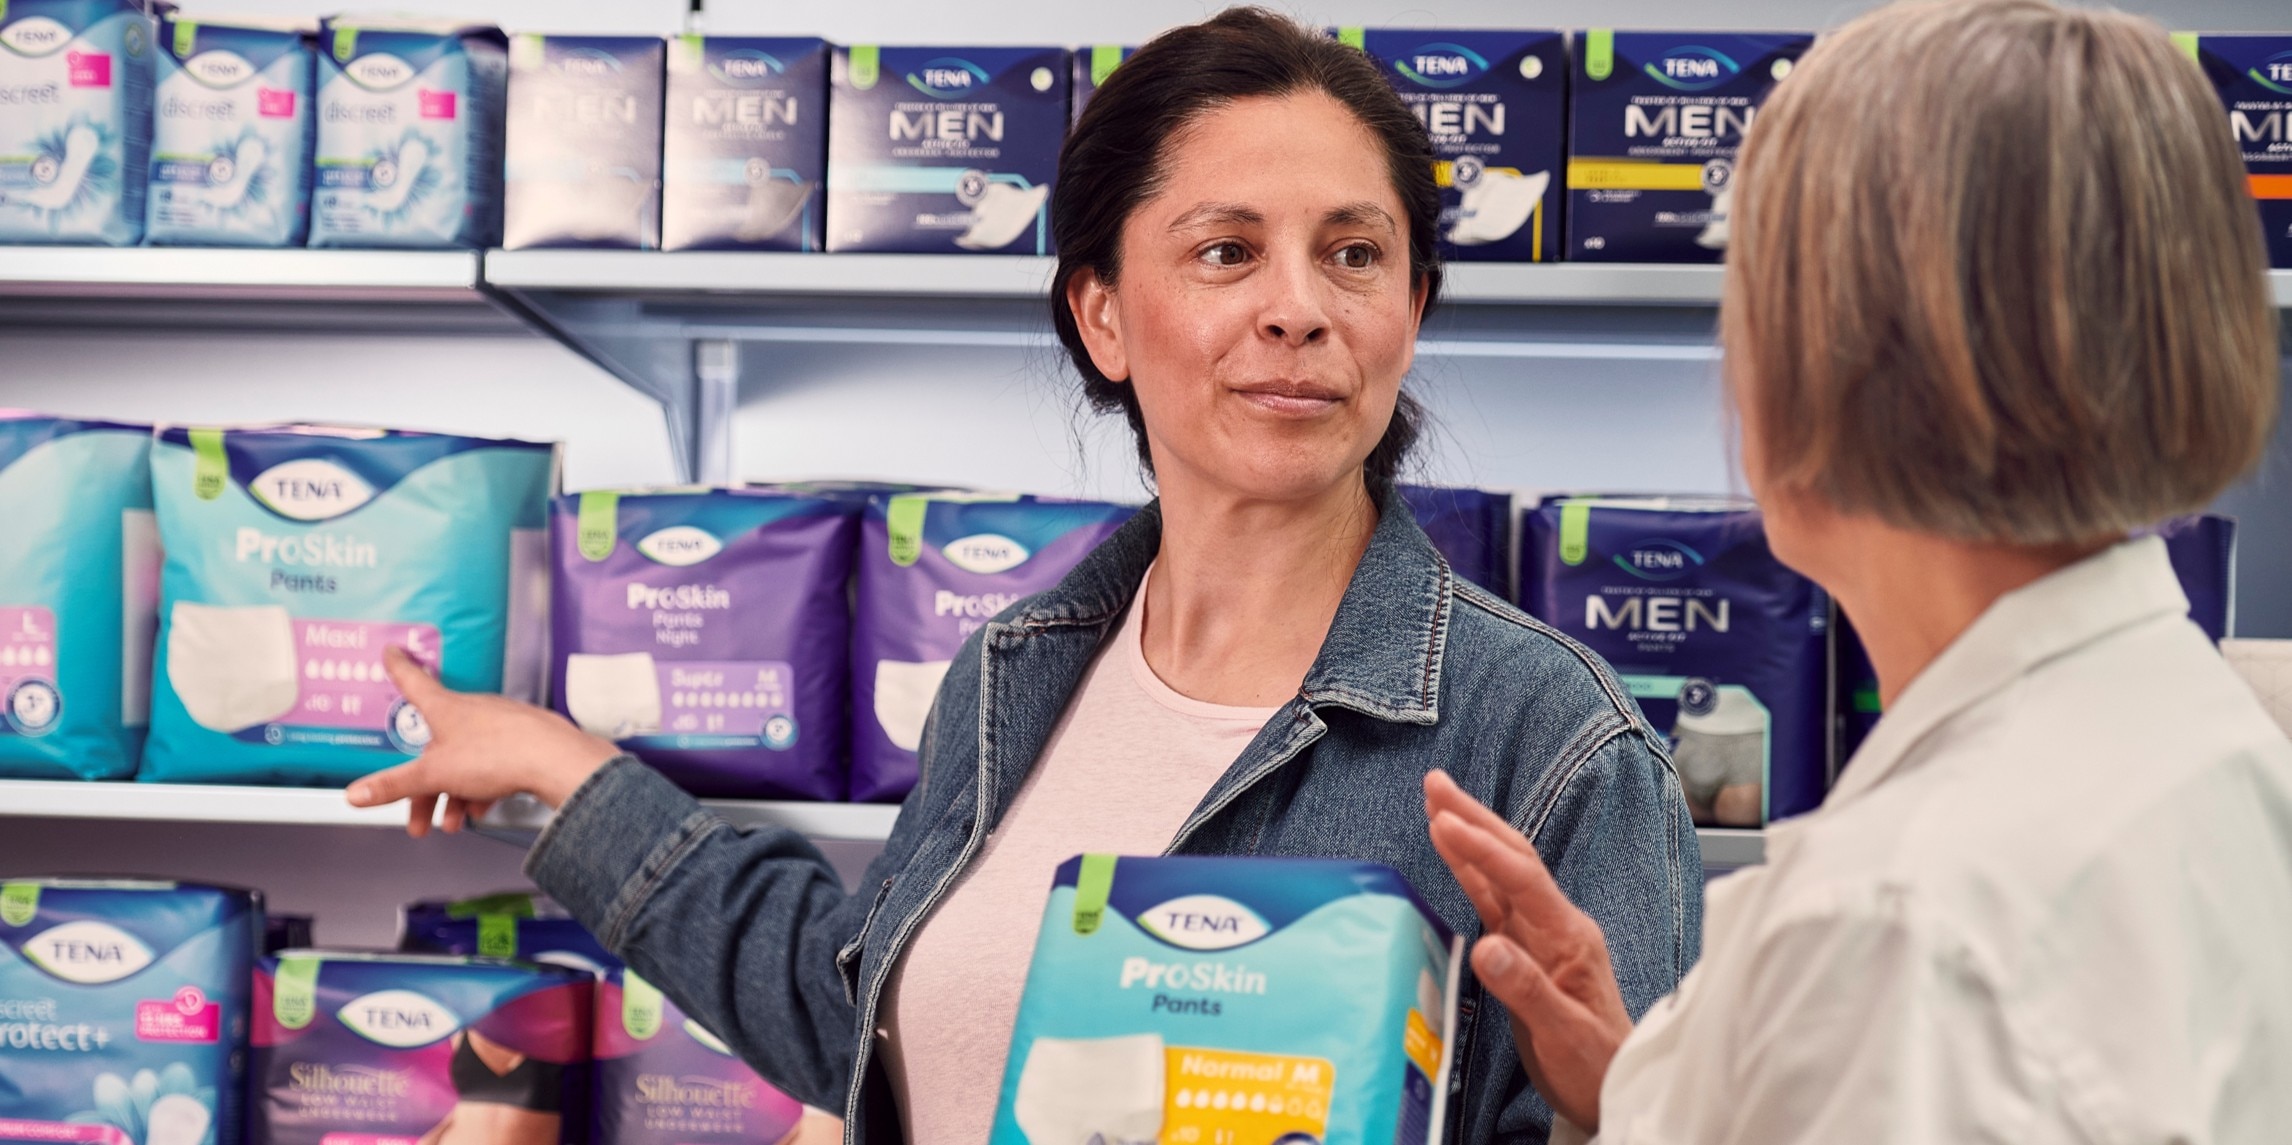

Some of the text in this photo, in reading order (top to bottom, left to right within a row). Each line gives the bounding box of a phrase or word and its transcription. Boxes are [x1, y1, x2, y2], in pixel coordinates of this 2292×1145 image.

[723, 59, 768, 77] TENA
[922, 68, 972, 88] TENA
[1413, 55, 1468, 76] TENA
[1662, 57, 1718, 79] TENA
[692, 97, 797, 126] MEN
[889, 109, 1004, 142] MEN
[275, 478, 343, 500] TENA
[235, 527, 377, 568] ProSkin
[1633, 551, 1684, 569] TENA
[270, 569, 338, 595] Pants
[627, 582, 731, 610] ProSkin
[1586, 594, 1730, 633] MEN
[305, 623, 368, 650] Maxi
[1167, 911, 1242, 935] TENA
[54, 941, 124, 962] TENA
[1120, 957, 1267, 995] ProSkin
[364, 1006, 432, 1029] TENA
[1152, 994, 1223, 1017] Pants
[289, 1060, 411, 1098] Silhouette
[1180, 1053, 1320, 1085] Normal M
[635, 1073, 757, 1109] Silhouette
